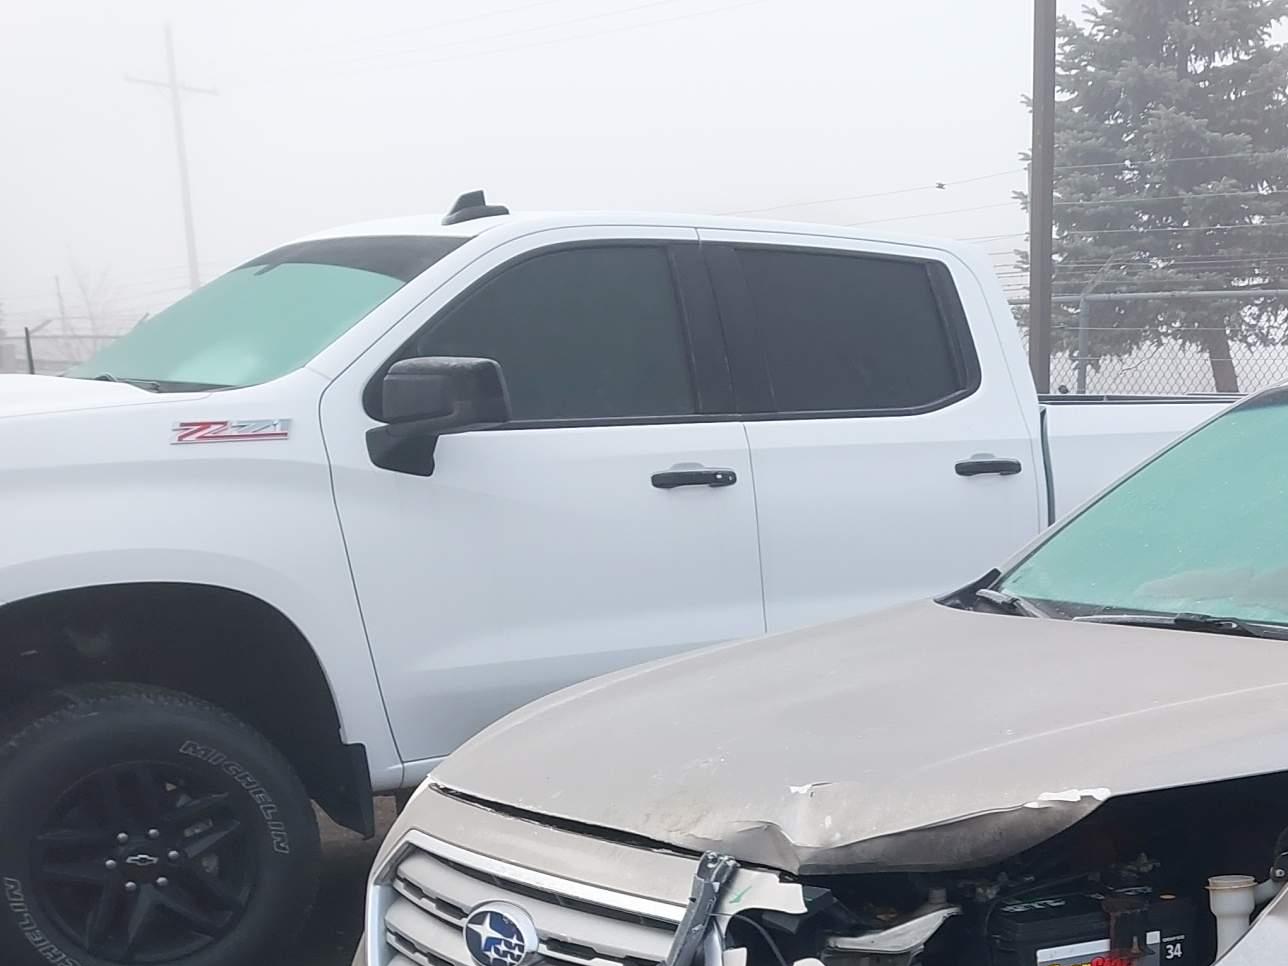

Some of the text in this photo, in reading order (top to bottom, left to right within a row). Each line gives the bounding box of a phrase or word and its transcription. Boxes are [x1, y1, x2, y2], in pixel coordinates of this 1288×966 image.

[172, 418, 292, 445] Z71
[179, 740, 289, 854] MICHELIN
[1165, 943, 1183, 959] 34
